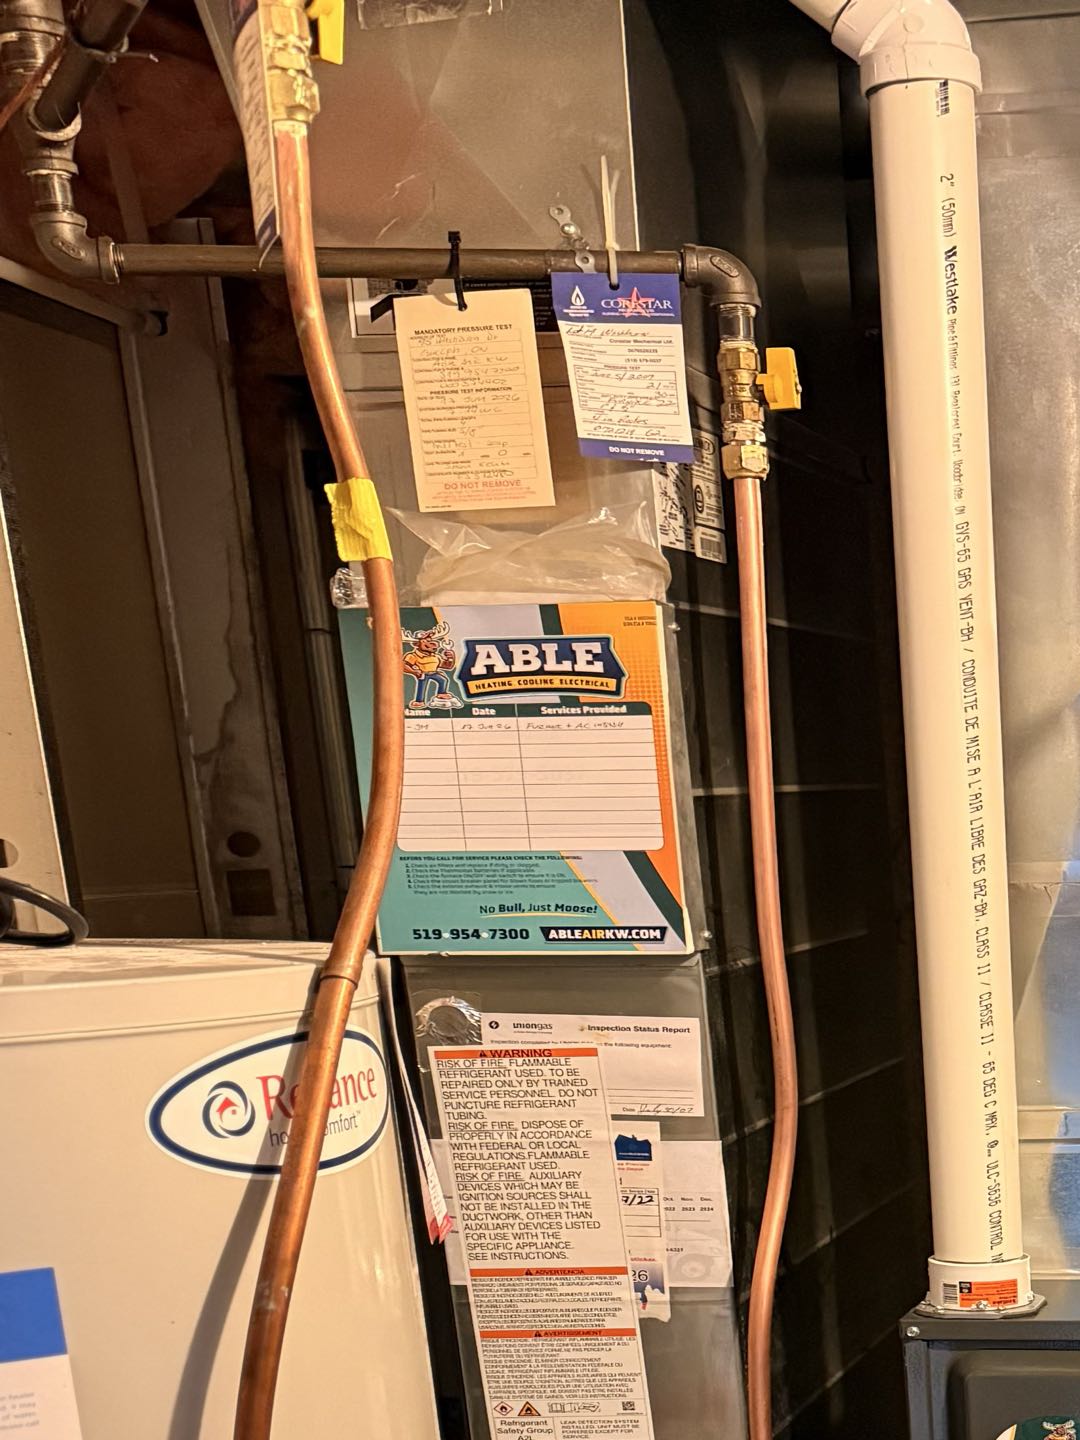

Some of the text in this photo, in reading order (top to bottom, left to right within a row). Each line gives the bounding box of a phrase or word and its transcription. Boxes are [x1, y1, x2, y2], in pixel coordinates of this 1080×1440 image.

[939, 173, 959, 316] 2" (50mm) Westlake
[470, 642, 604, 675] ABLE
[476, 680, 512, 690] HEATING
[560, 679, 610, 688] ELECTRICAL
[541, 705, 627, 714] Services Provided
[956, 521, 1003, 1251] GVS-65 GAS VENT-BH CONDUITE DE MISE L'AIR LIBRE DES CLASS CLASSE 65 DEG ULC-S636 CONTROL
[480, 904, 597, 914] No Bull, Just Moose!
[549, 929, 661, 939] ABLEAIRKW.COM
[587, 1025, 631, 1033] Inspection
[490, 1049, 552, 1057] WARNING
[509, 1058, 571, 1066] FLAMMABLE
[440, 1069, 511, 1078] REFRIGERANT
[567, 1068, 580, 1076] BE
[441, 1079, 588, 1089] REPAIRED ONLY BY TRAINED
[256, 1068, 377, 1121] Rance
[443, 1091, 487, 1099] SERVICE
[577, 1089, 598, 1097] NOT
[444, 1100, 577, 1109] PUNCTURE REFRIGERANT
[446, 1112, 486, 1120] TUBING.
[449, 1122, 472, 1130] RISK
[521, 1120, 567, 1129] DISPOSE
[570, 1120, 584, 1128] OF
[450, 1130, 592, 1140] PROPERLY IN ACCORDANCE
[450, 1141, 581, 1150] WITH FEDERAL OR LOCAL
[454, 1161, 560, 1170] REFRIGERANT USED.
[456, 1171, 582, 1181] RISK OF AUXILIARY
[457, 1183, 501, 1191] DEVICES
[504, 1182, 538, 1190] WHICH
[541, 1182, 562, 1190] MAY
[459, 1193, 503, 1201] IGNITION
[506, 1192, 557, 1200] SOURCES
[460, 1203, 482, 1211] NOT
[485, 1203, 497, 1211] BE
[501, 1202, 555, 1210] INSTALLED
[572, 1201, 591, 1209] THE
[526, 1212, 563, 1220] OTHER
[464, 1221, 600, 1231] AUXILIARY DEVICES LISTED
[489, 1232, 509, 1240] USE
[512, 1232, 538, 1240] WITH
[467, 1242, 574, 1250] SPECIFIC APPLIANCE.
[468, 1252, 569, 1261] SEE INSTRUCTIONS.
[497, 1427, 553, 1435] Safety Group
